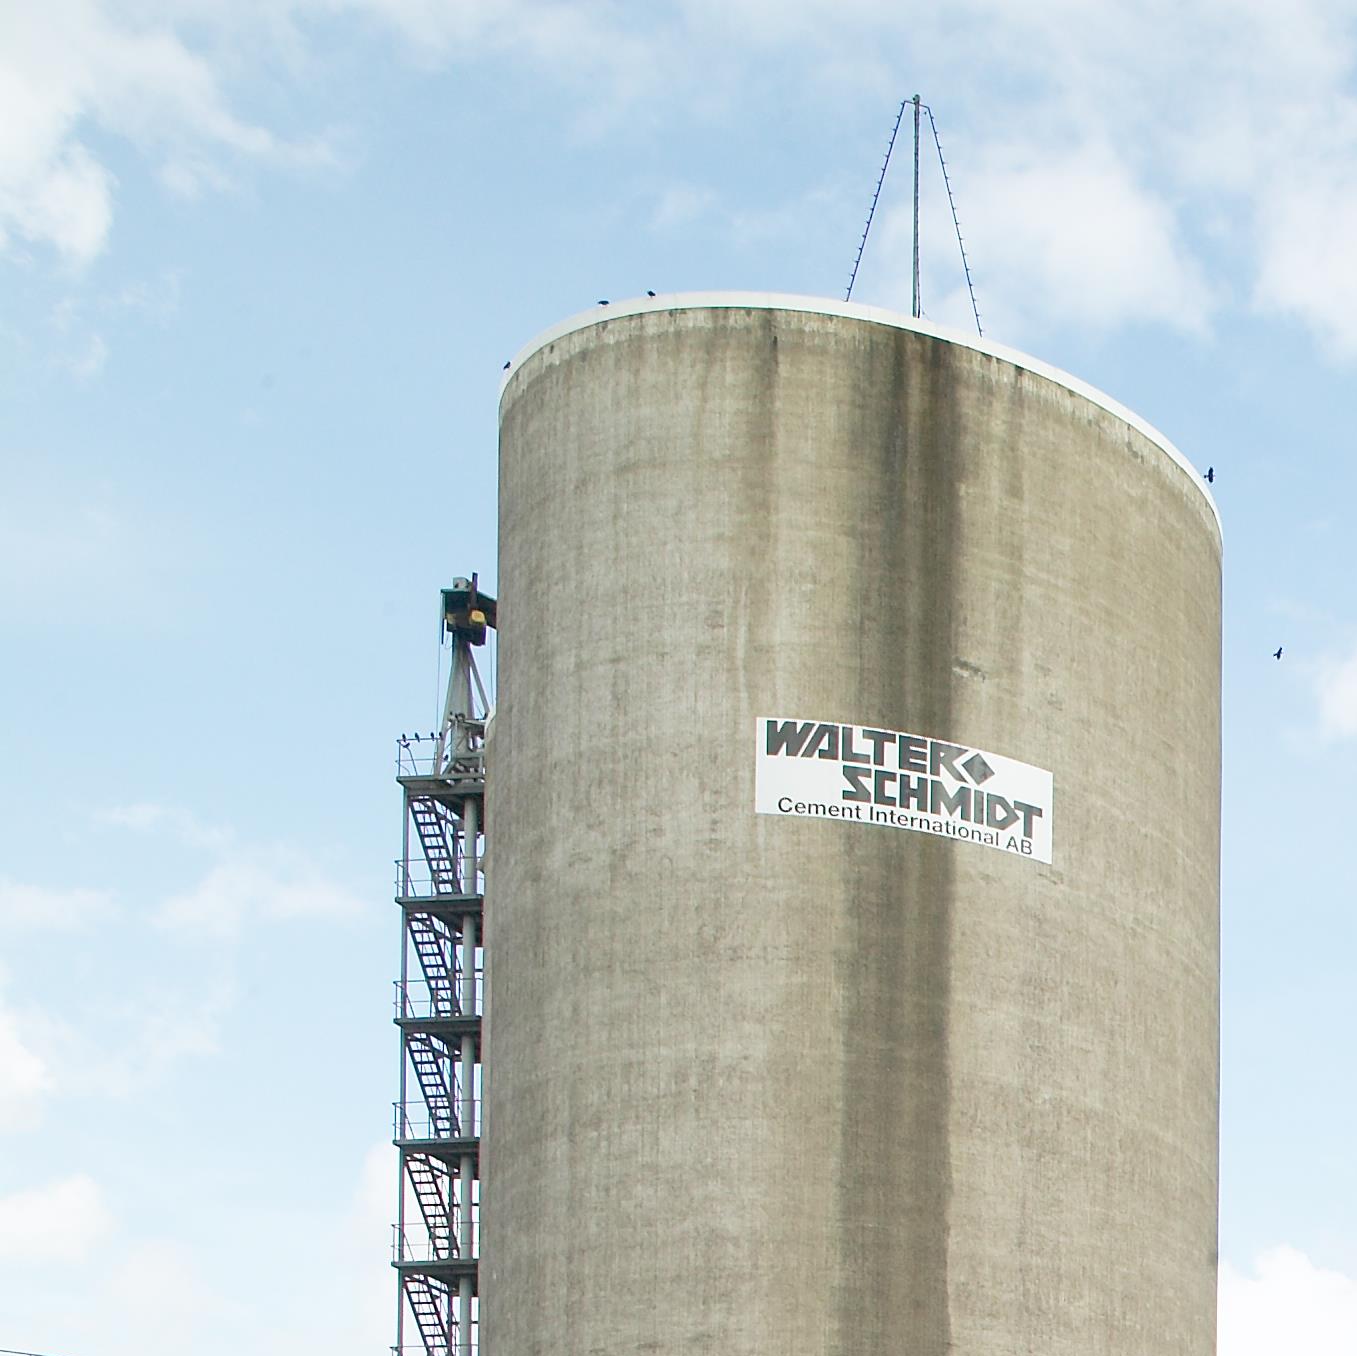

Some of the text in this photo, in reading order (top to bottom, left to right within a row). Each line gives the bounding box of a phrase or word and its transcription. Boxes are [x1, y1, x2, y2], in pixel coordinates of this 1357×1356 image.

[766, 719, 970, 784] WALTER
[777, 796, 1033, 856] Cement International AB
[842, 764, 1044, 839] SCHMIDT
